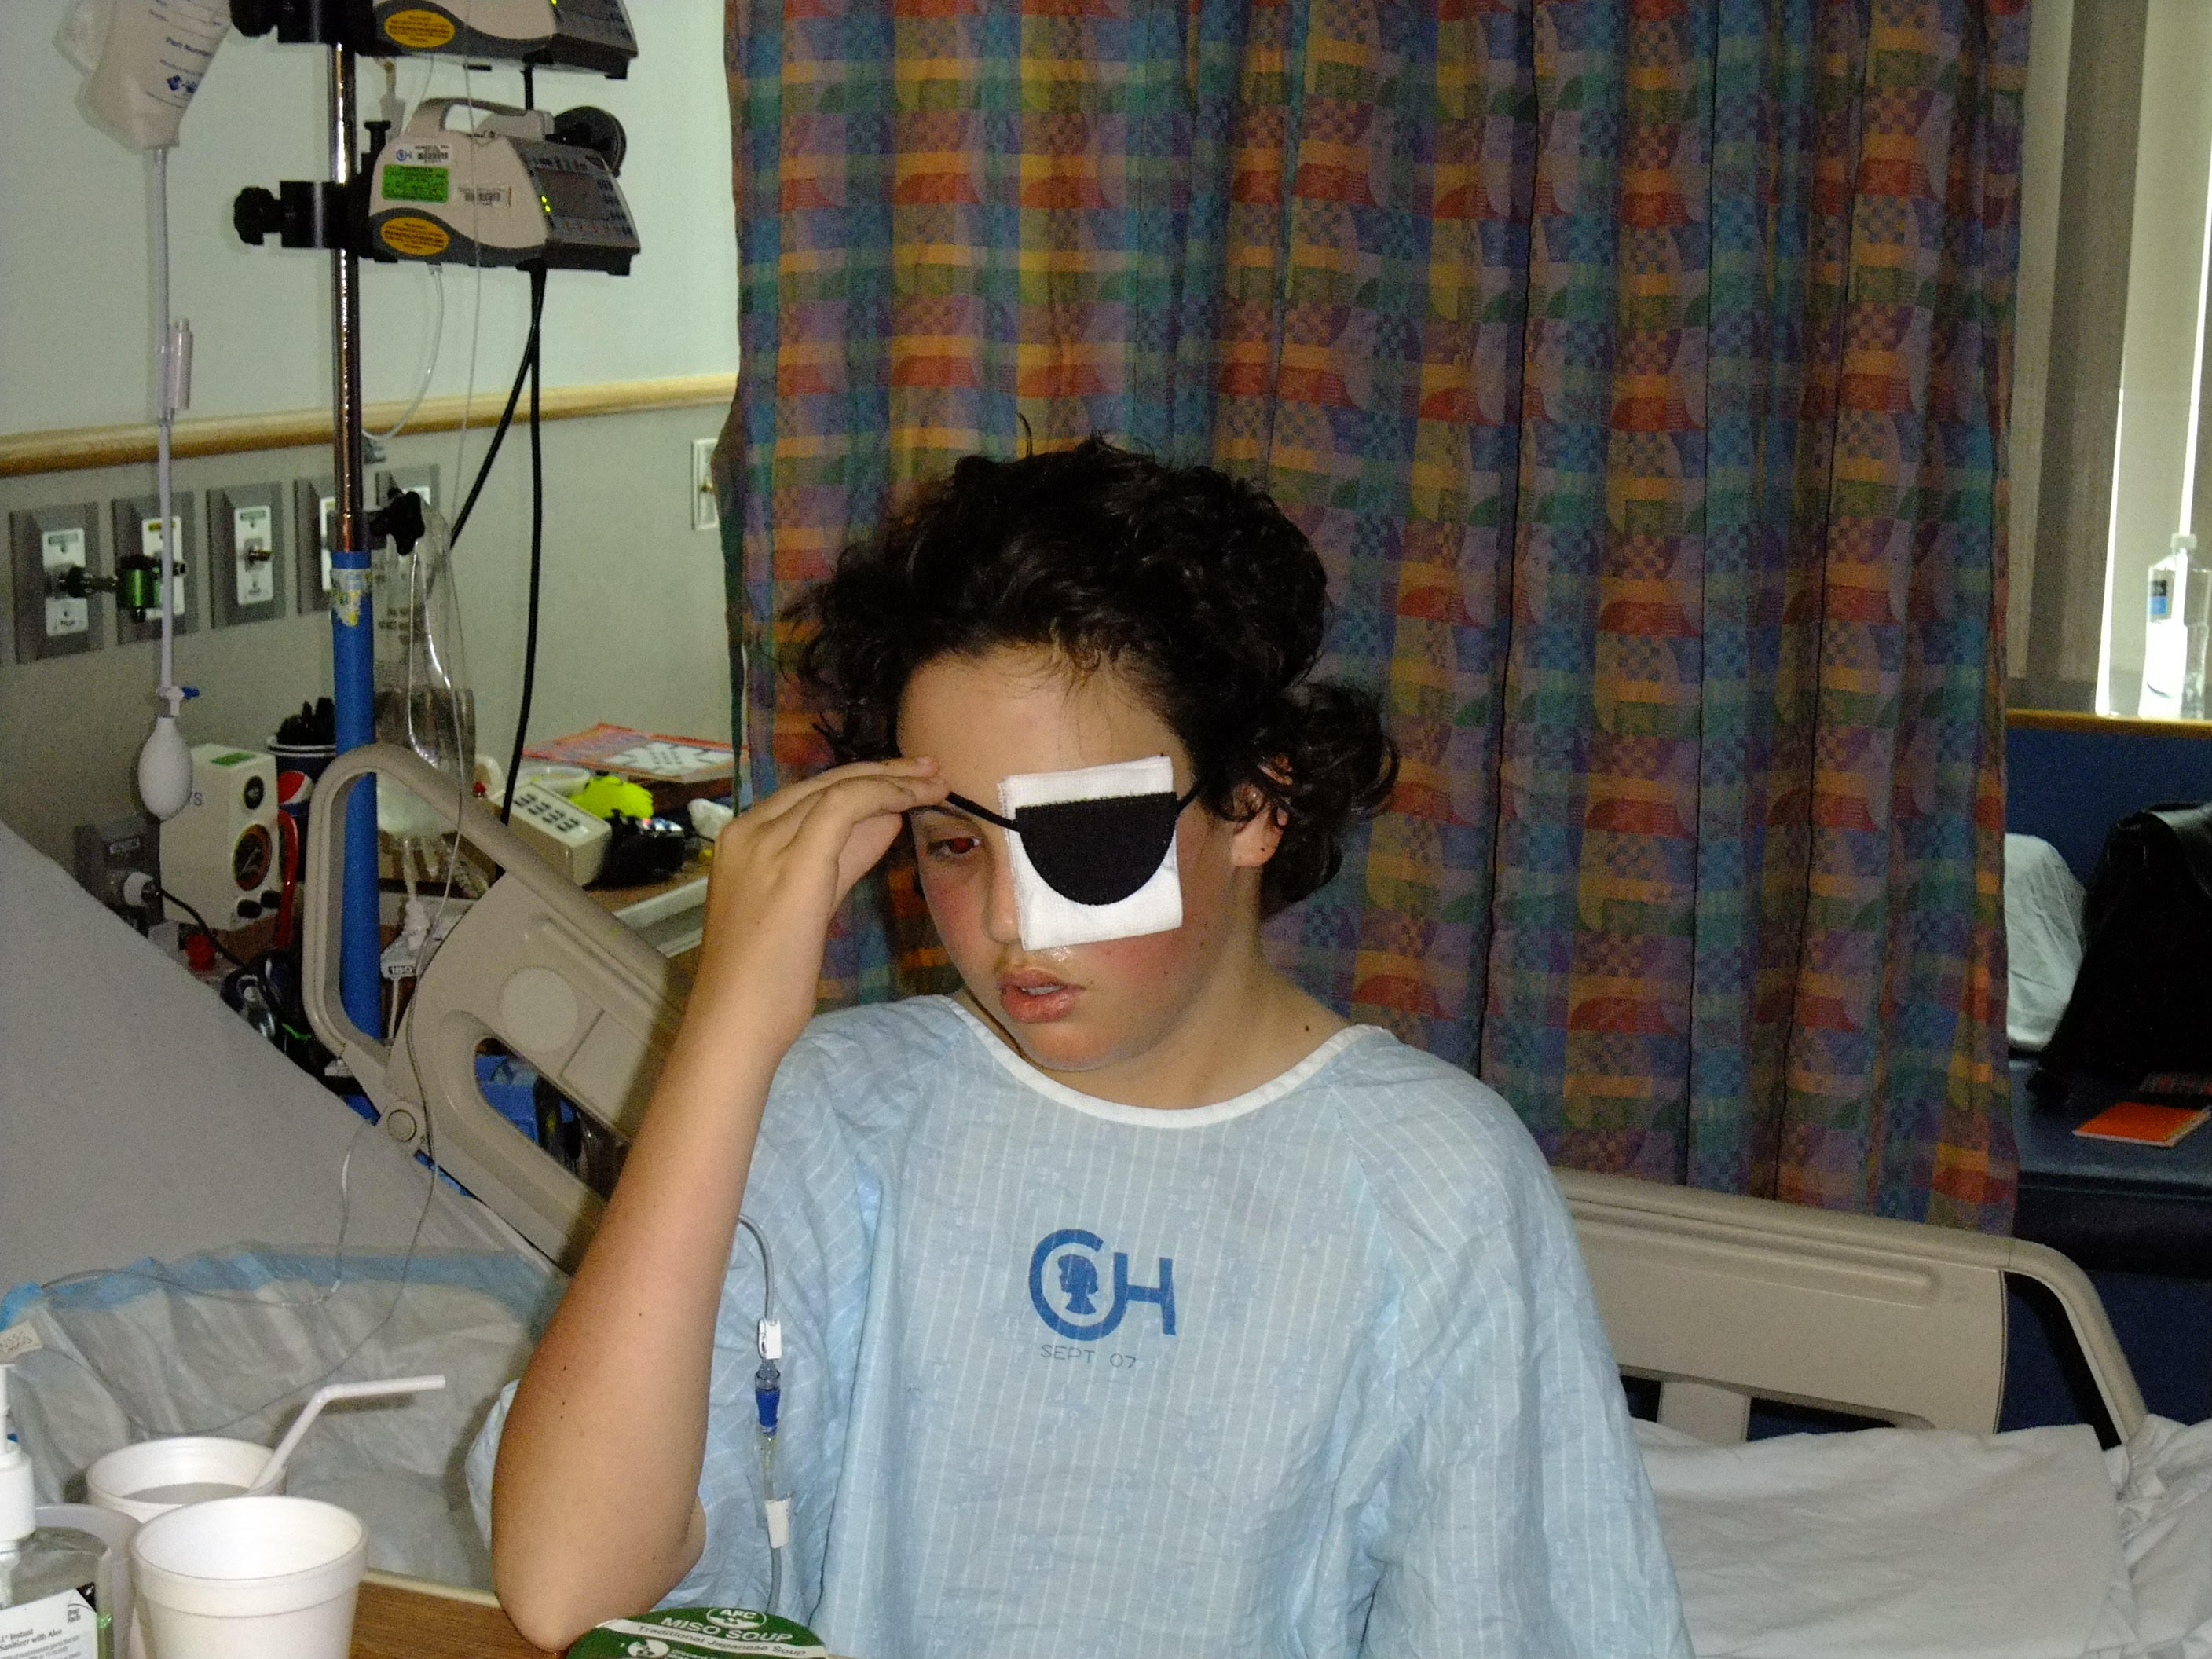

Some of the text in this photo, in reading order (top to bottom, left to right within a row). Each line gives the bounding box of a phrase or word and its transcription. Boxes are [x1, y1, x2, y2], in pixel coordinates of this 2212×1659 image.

[1041, 1344, 1137, 1368] SEPT 07
[720, 1609, 756, 1619] AFC
[639, 1626, 806, 1657] Traditional Japanese Soup
[661, 1617, 793, 1643] MISO SOUP
